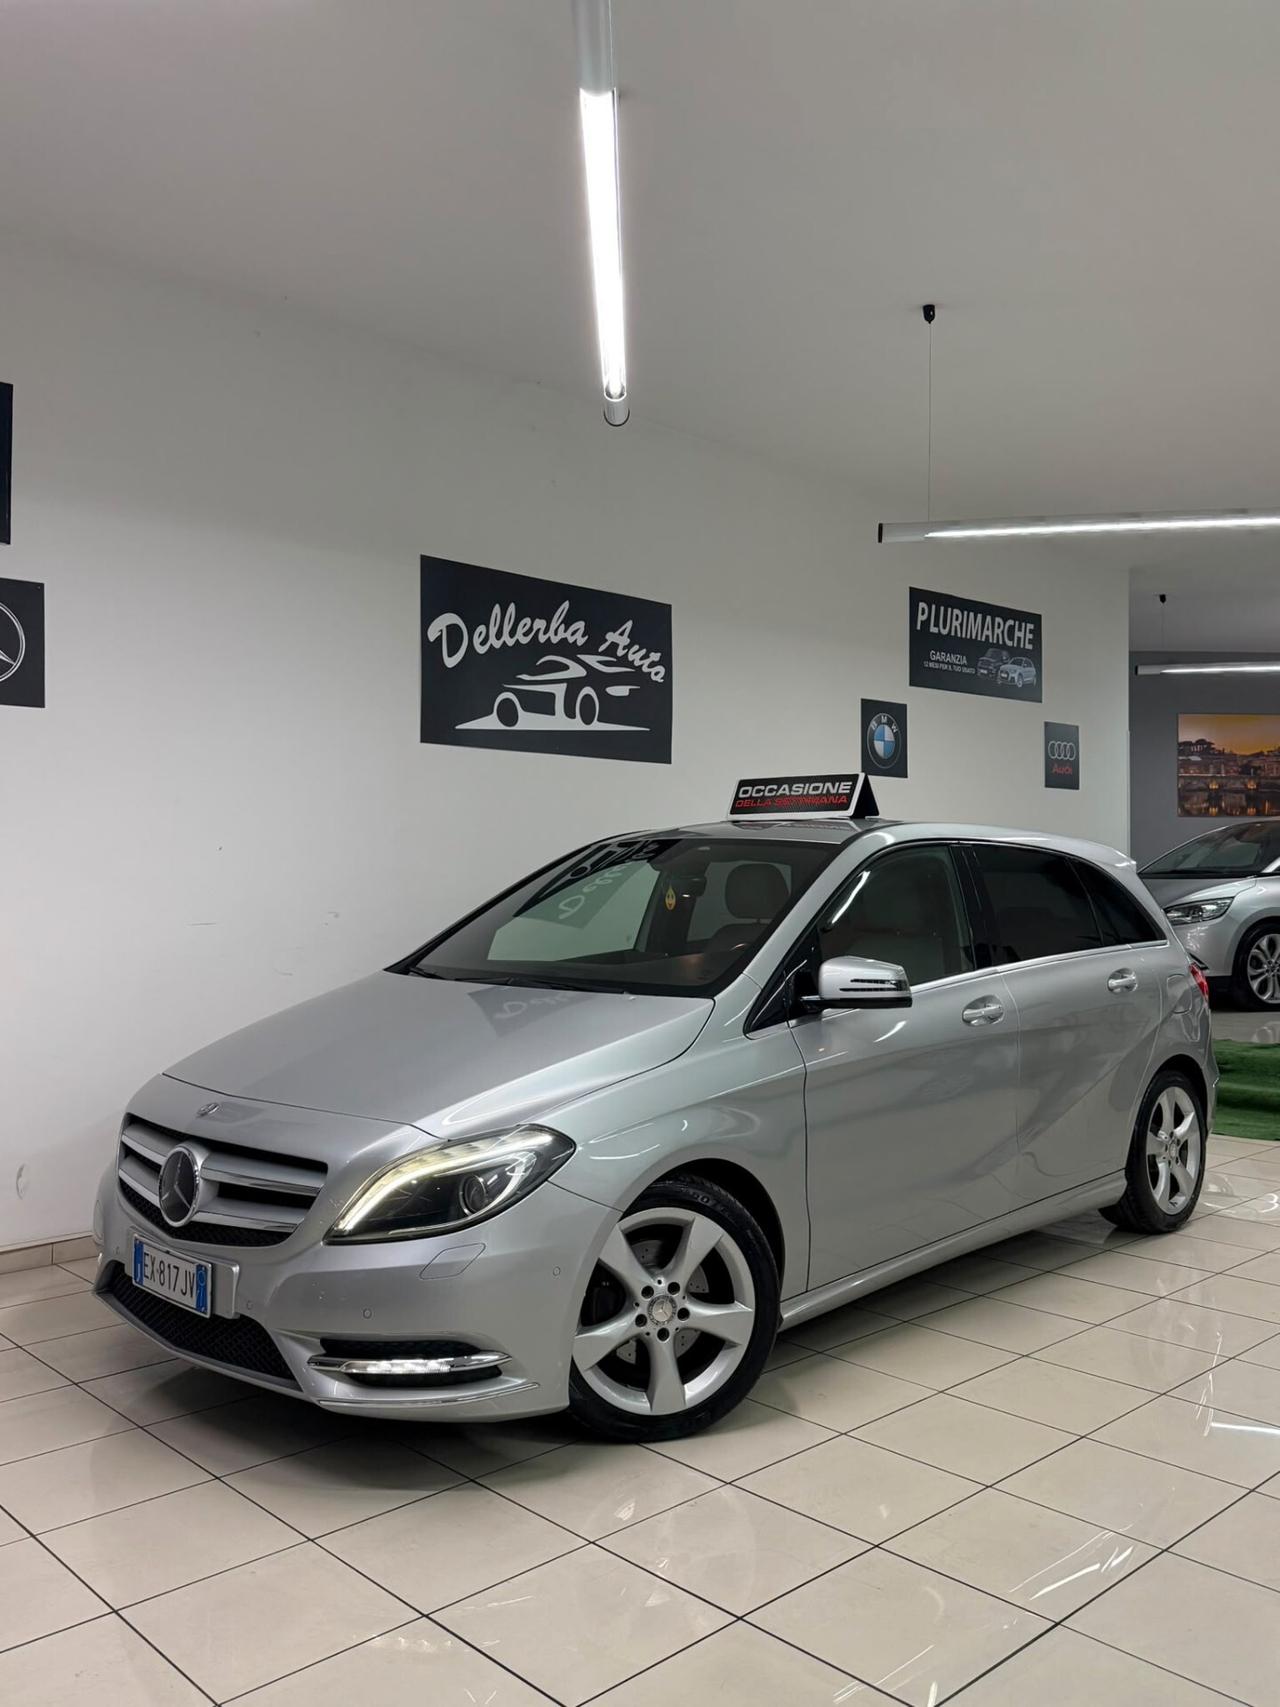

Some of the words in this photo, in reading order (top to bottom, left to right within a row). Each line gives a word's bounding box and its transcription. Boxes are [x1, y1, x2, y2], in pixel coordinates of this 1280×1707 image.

[427, 600, 588, 668] Dellerba
[598, 620, 666, 683] Auto
[916, 602, 1035, 650] PLURIMARCHE
[929, 650, 968, 666] GARANZIA
[735, 799, 772, 808] DELLA
[738, 781, 853, 798] OCCASIONE
[143, 1252, 156, 1282] EX
[159, 1260, 179, 1292] 817
[181, 1270, 195, 1298] JV
